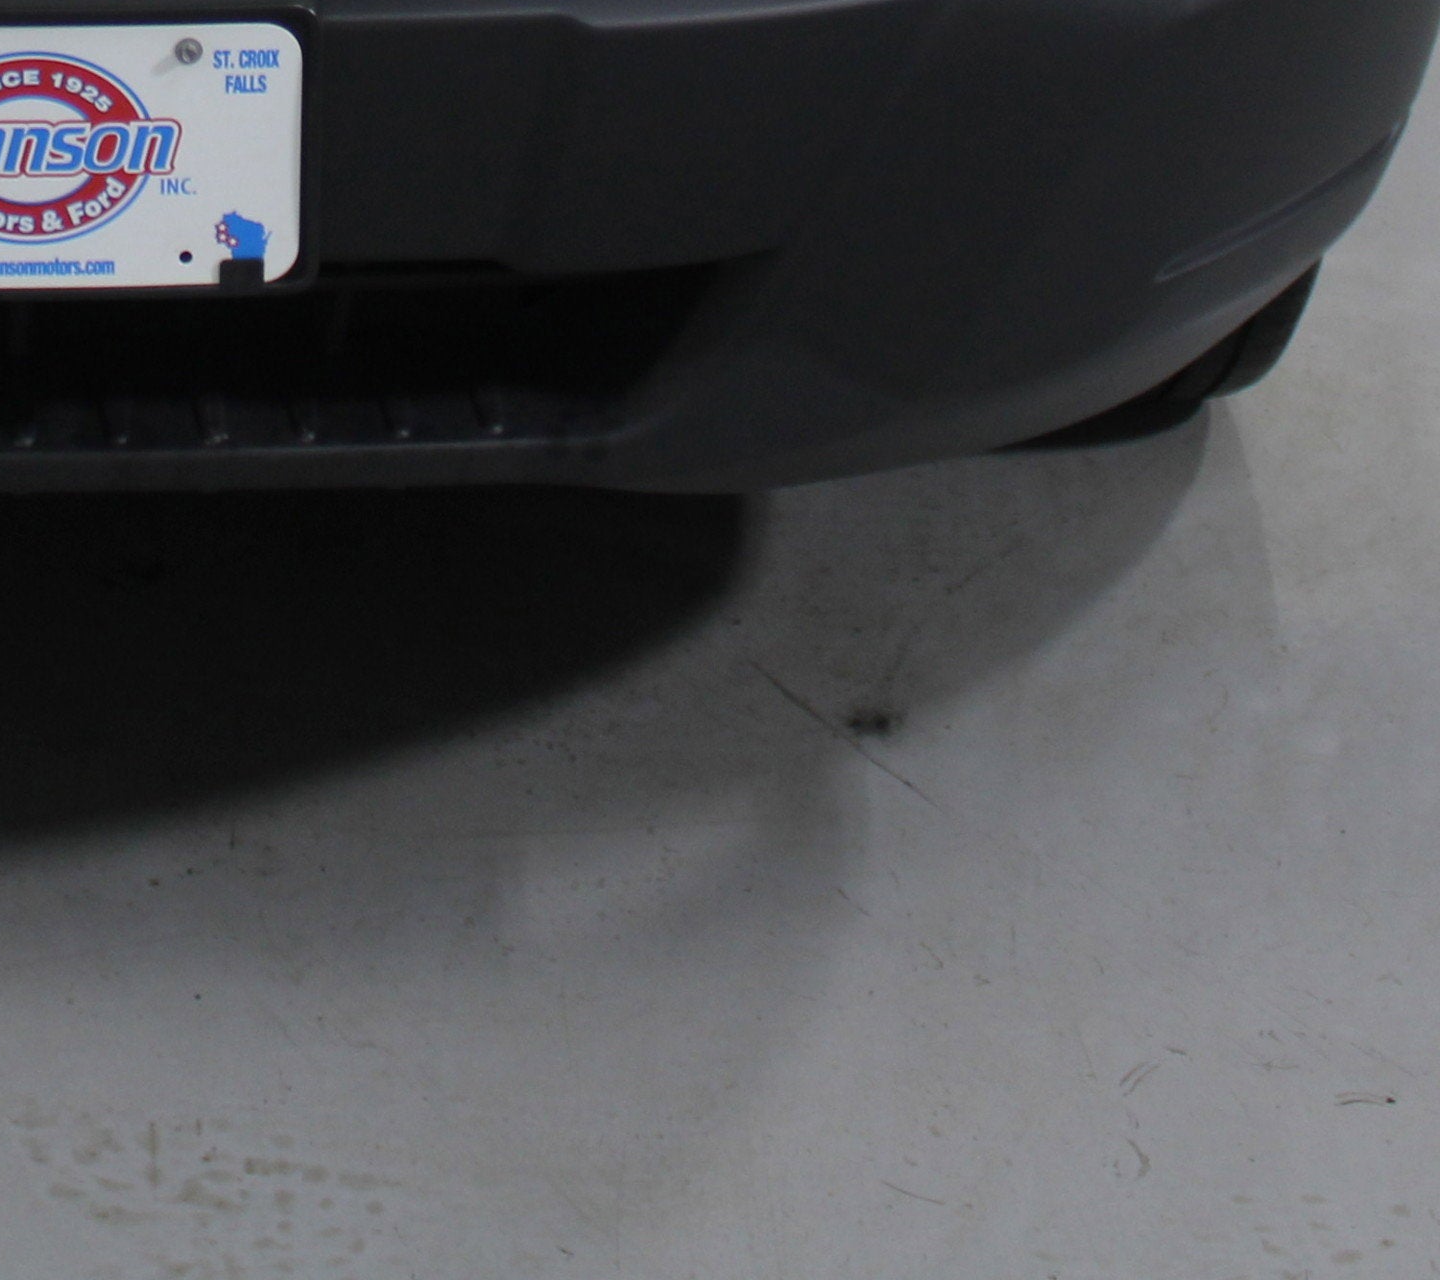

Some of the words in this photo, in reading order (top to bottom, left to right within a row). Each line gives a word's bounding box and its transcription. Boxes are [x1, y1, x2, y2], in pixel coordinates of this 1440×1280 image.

[212, 50, 235, 69] ST.
[238, 49, 280, 69] CROIX
[51, 71, 112, 113] 1925
[224, 74, 267, 94] FALLS
[159, 178, 198, 196] INC.
[41, 209, 64, 234] &
[68, 177, 126, 225] Ford
